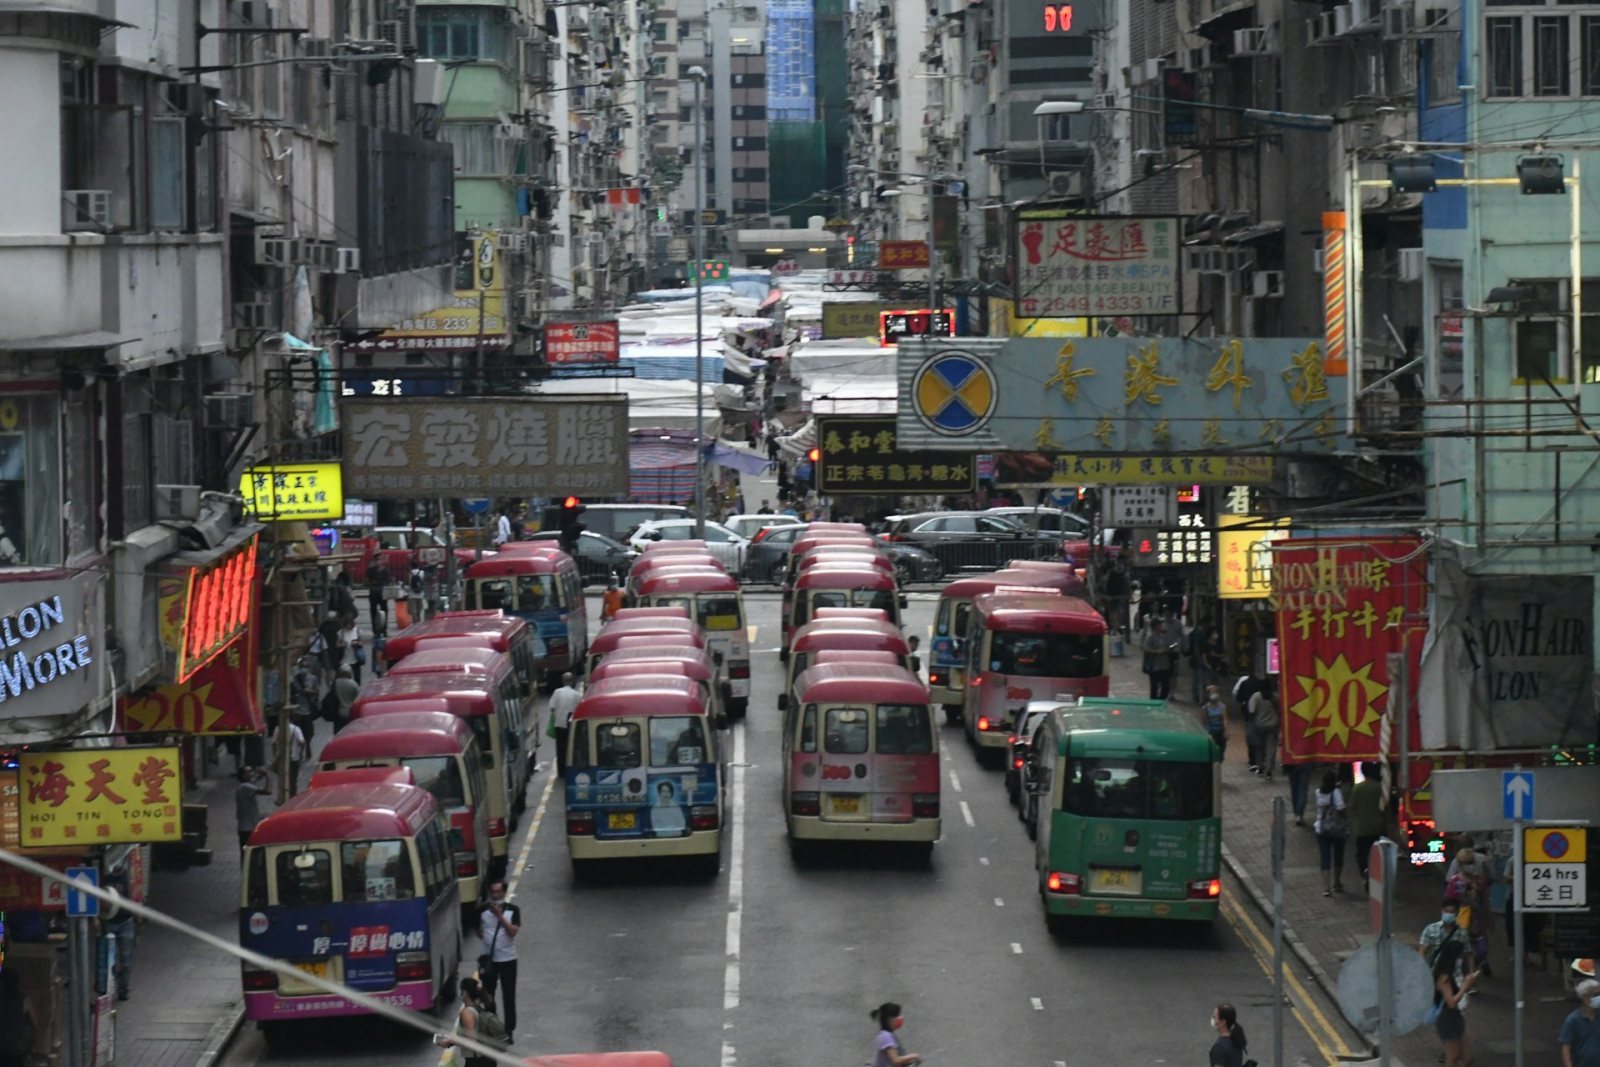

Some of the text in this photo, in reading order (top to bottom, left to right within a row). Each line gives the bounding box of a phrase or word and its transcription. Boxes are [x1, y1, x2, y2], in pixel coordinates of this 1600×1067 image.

[1057, 283, 1119, 295] MASSAGE
[1121, 282, 1171, 293] BEAUTY
[1094, 297, 1143, 311] 4333
[143, 691, 204, 732] 20
[1308, 678, 1368, 731] 20
[26, 756, 176, 807] 海天堂
[30, 813, 57, 822] HOI
[76, 811, 102, 820] TIN
[122, 808, 163, 819] TONG
[1531, 867, 1579, 880] 24 hrs
[1536, 884, 1574, 901] 全日
